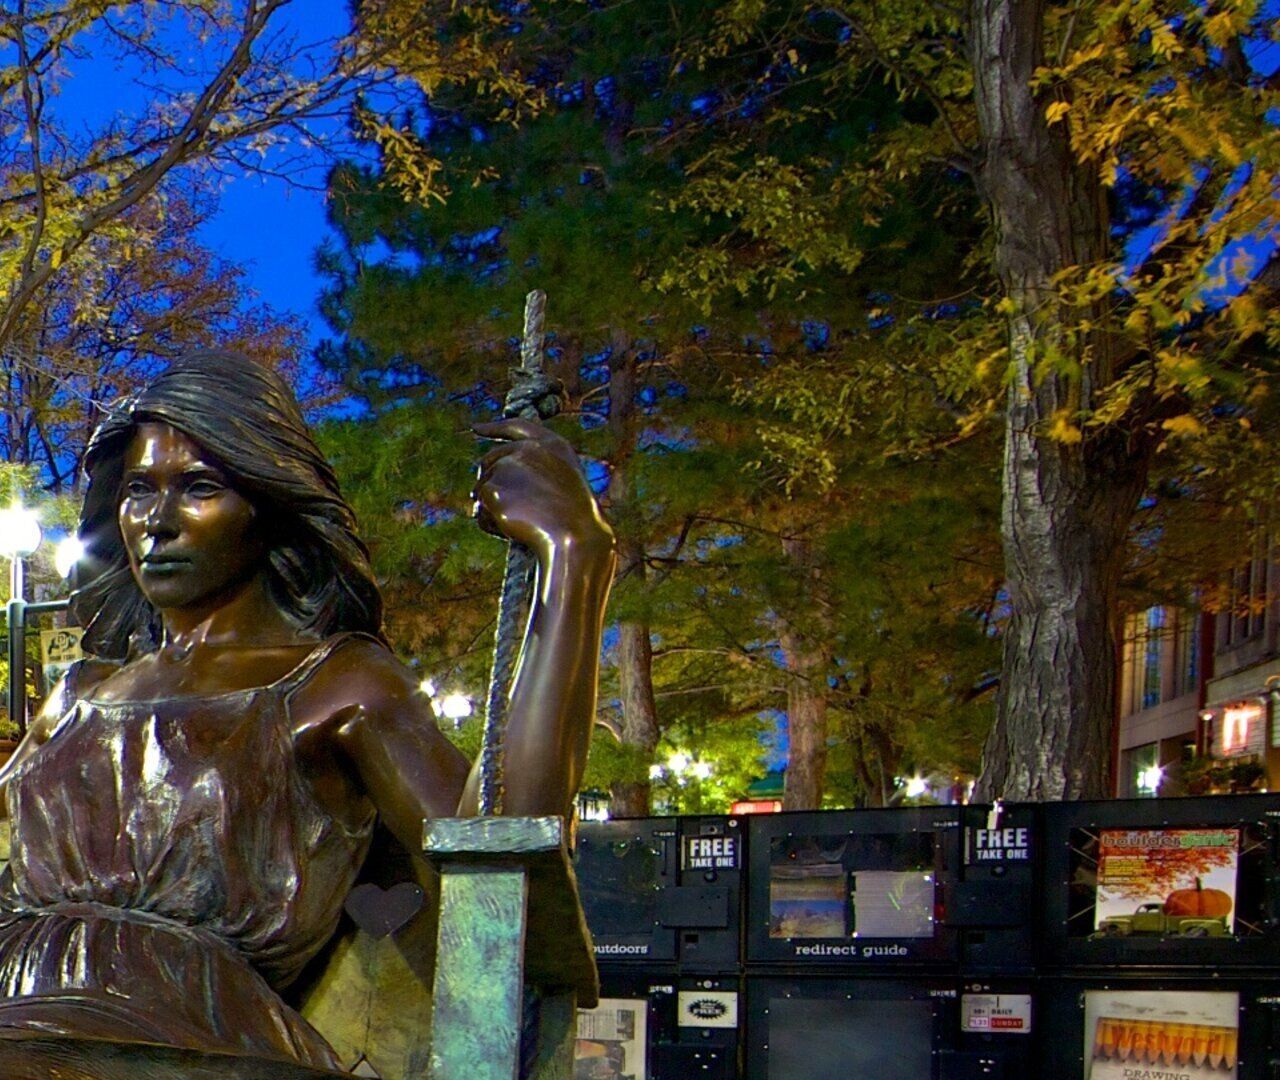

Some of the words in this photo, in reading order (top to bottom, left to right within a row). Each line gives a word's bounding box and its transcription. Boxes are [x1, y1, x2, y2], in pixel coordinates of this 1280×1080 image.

[976, 828, 1028, 848] FREE
[690, 838, 734, 857] FREE
[977, 849, 1003, 860] TAKE
[1006, 848, 1028, 859] ONE
[691, 858, 713, 868] TAKE
[716, 857, 734, 868] ONE
[795, 944, 856, 956] redirect
[863, 944, 908, 958] guide
